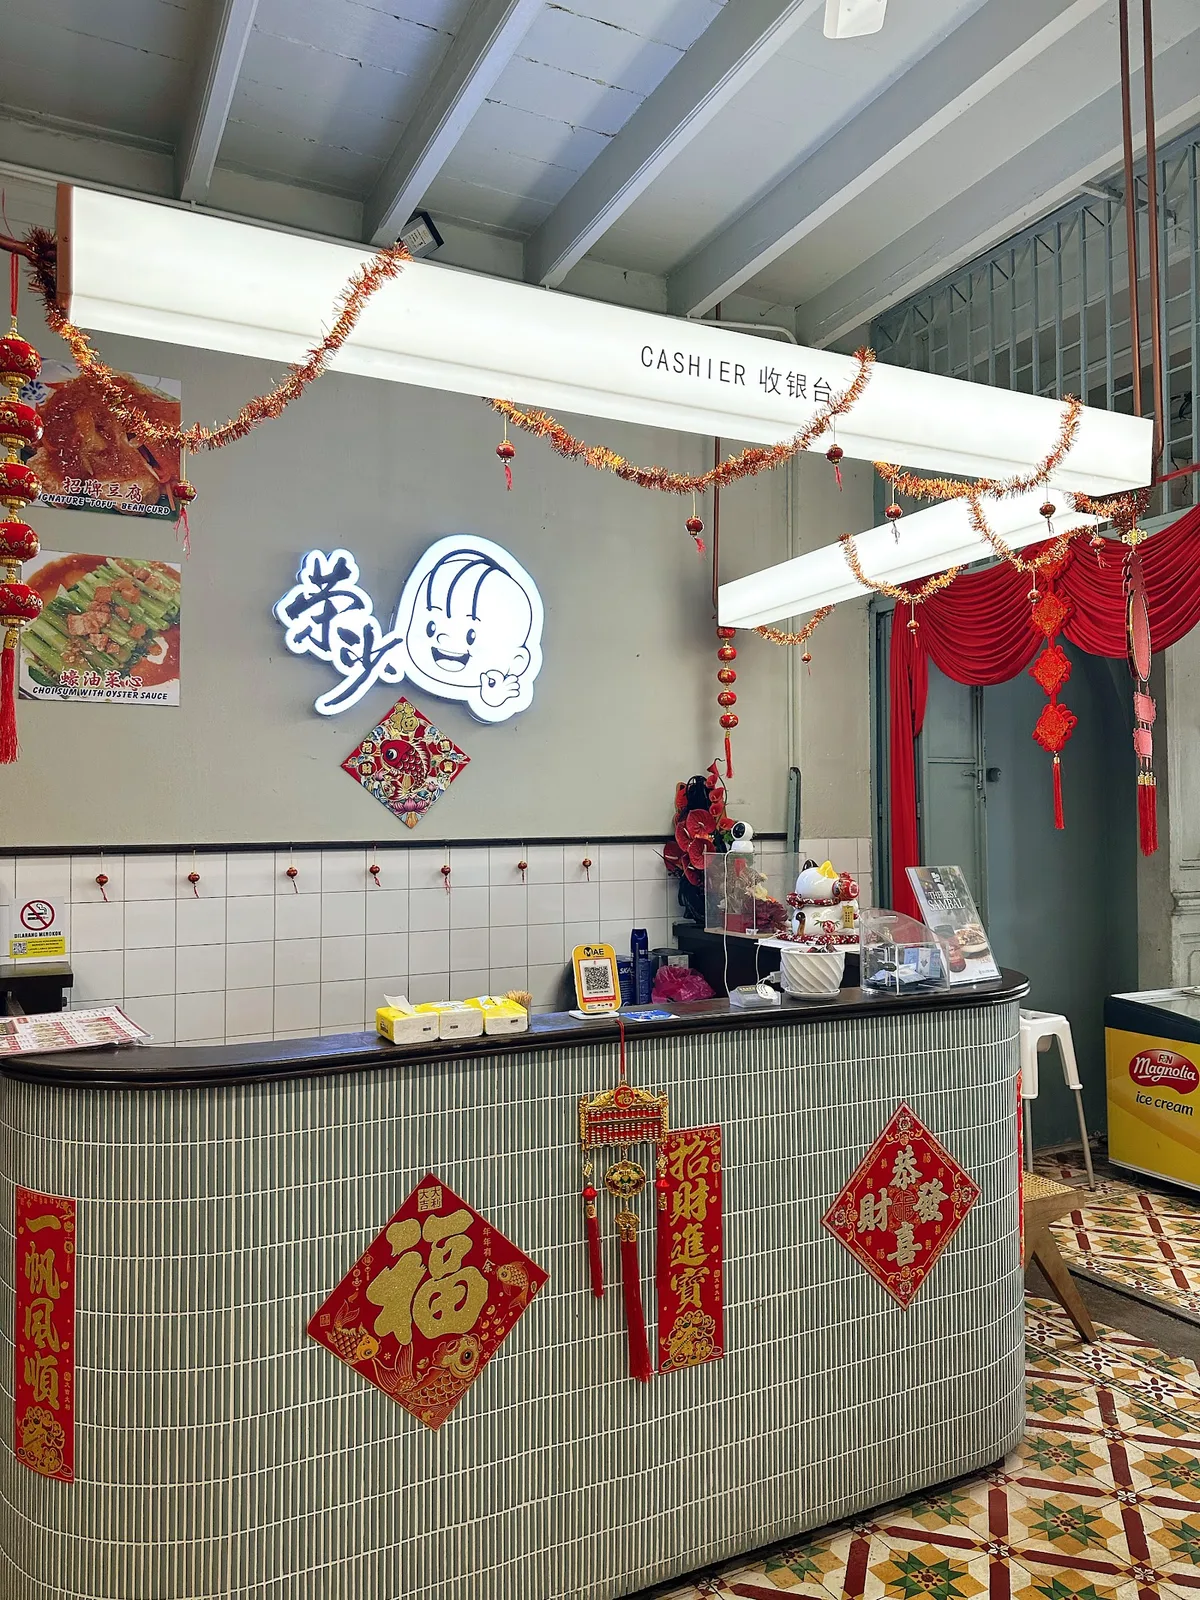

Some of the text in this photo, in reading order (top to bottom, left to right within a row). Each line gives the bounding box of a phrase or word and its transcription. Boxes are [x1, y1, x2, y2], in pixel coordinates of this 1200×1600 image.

[641, 345, 832, 403] CASHIER 收银台
[63, 476, 142, 503] 招牌豆腐
[38, 493, 84, 506] IGNATURE
[121, 502, 145, 513] BEAN
[145, 505, 170, 515] CURD
[60, 669, 143, 690] 蠔油菜心
[32, 687, 168, 700] CHOI SUM WITH OYSTER SAUCE
[928, 898, 966, 911] SAMBAL
[584, 946, 604, 957] MAE
[1133, 1057, 1197, 1082] Magnolia
[1158, 1053, 1174, 1065] F&N
[617, 1089, 633, 1105] 福
[1136, 1091, 1193, 1116] ice cream
[365, 1208, 489, 1346] 福
[24, 1213, 61, 1411] 一帆風順
